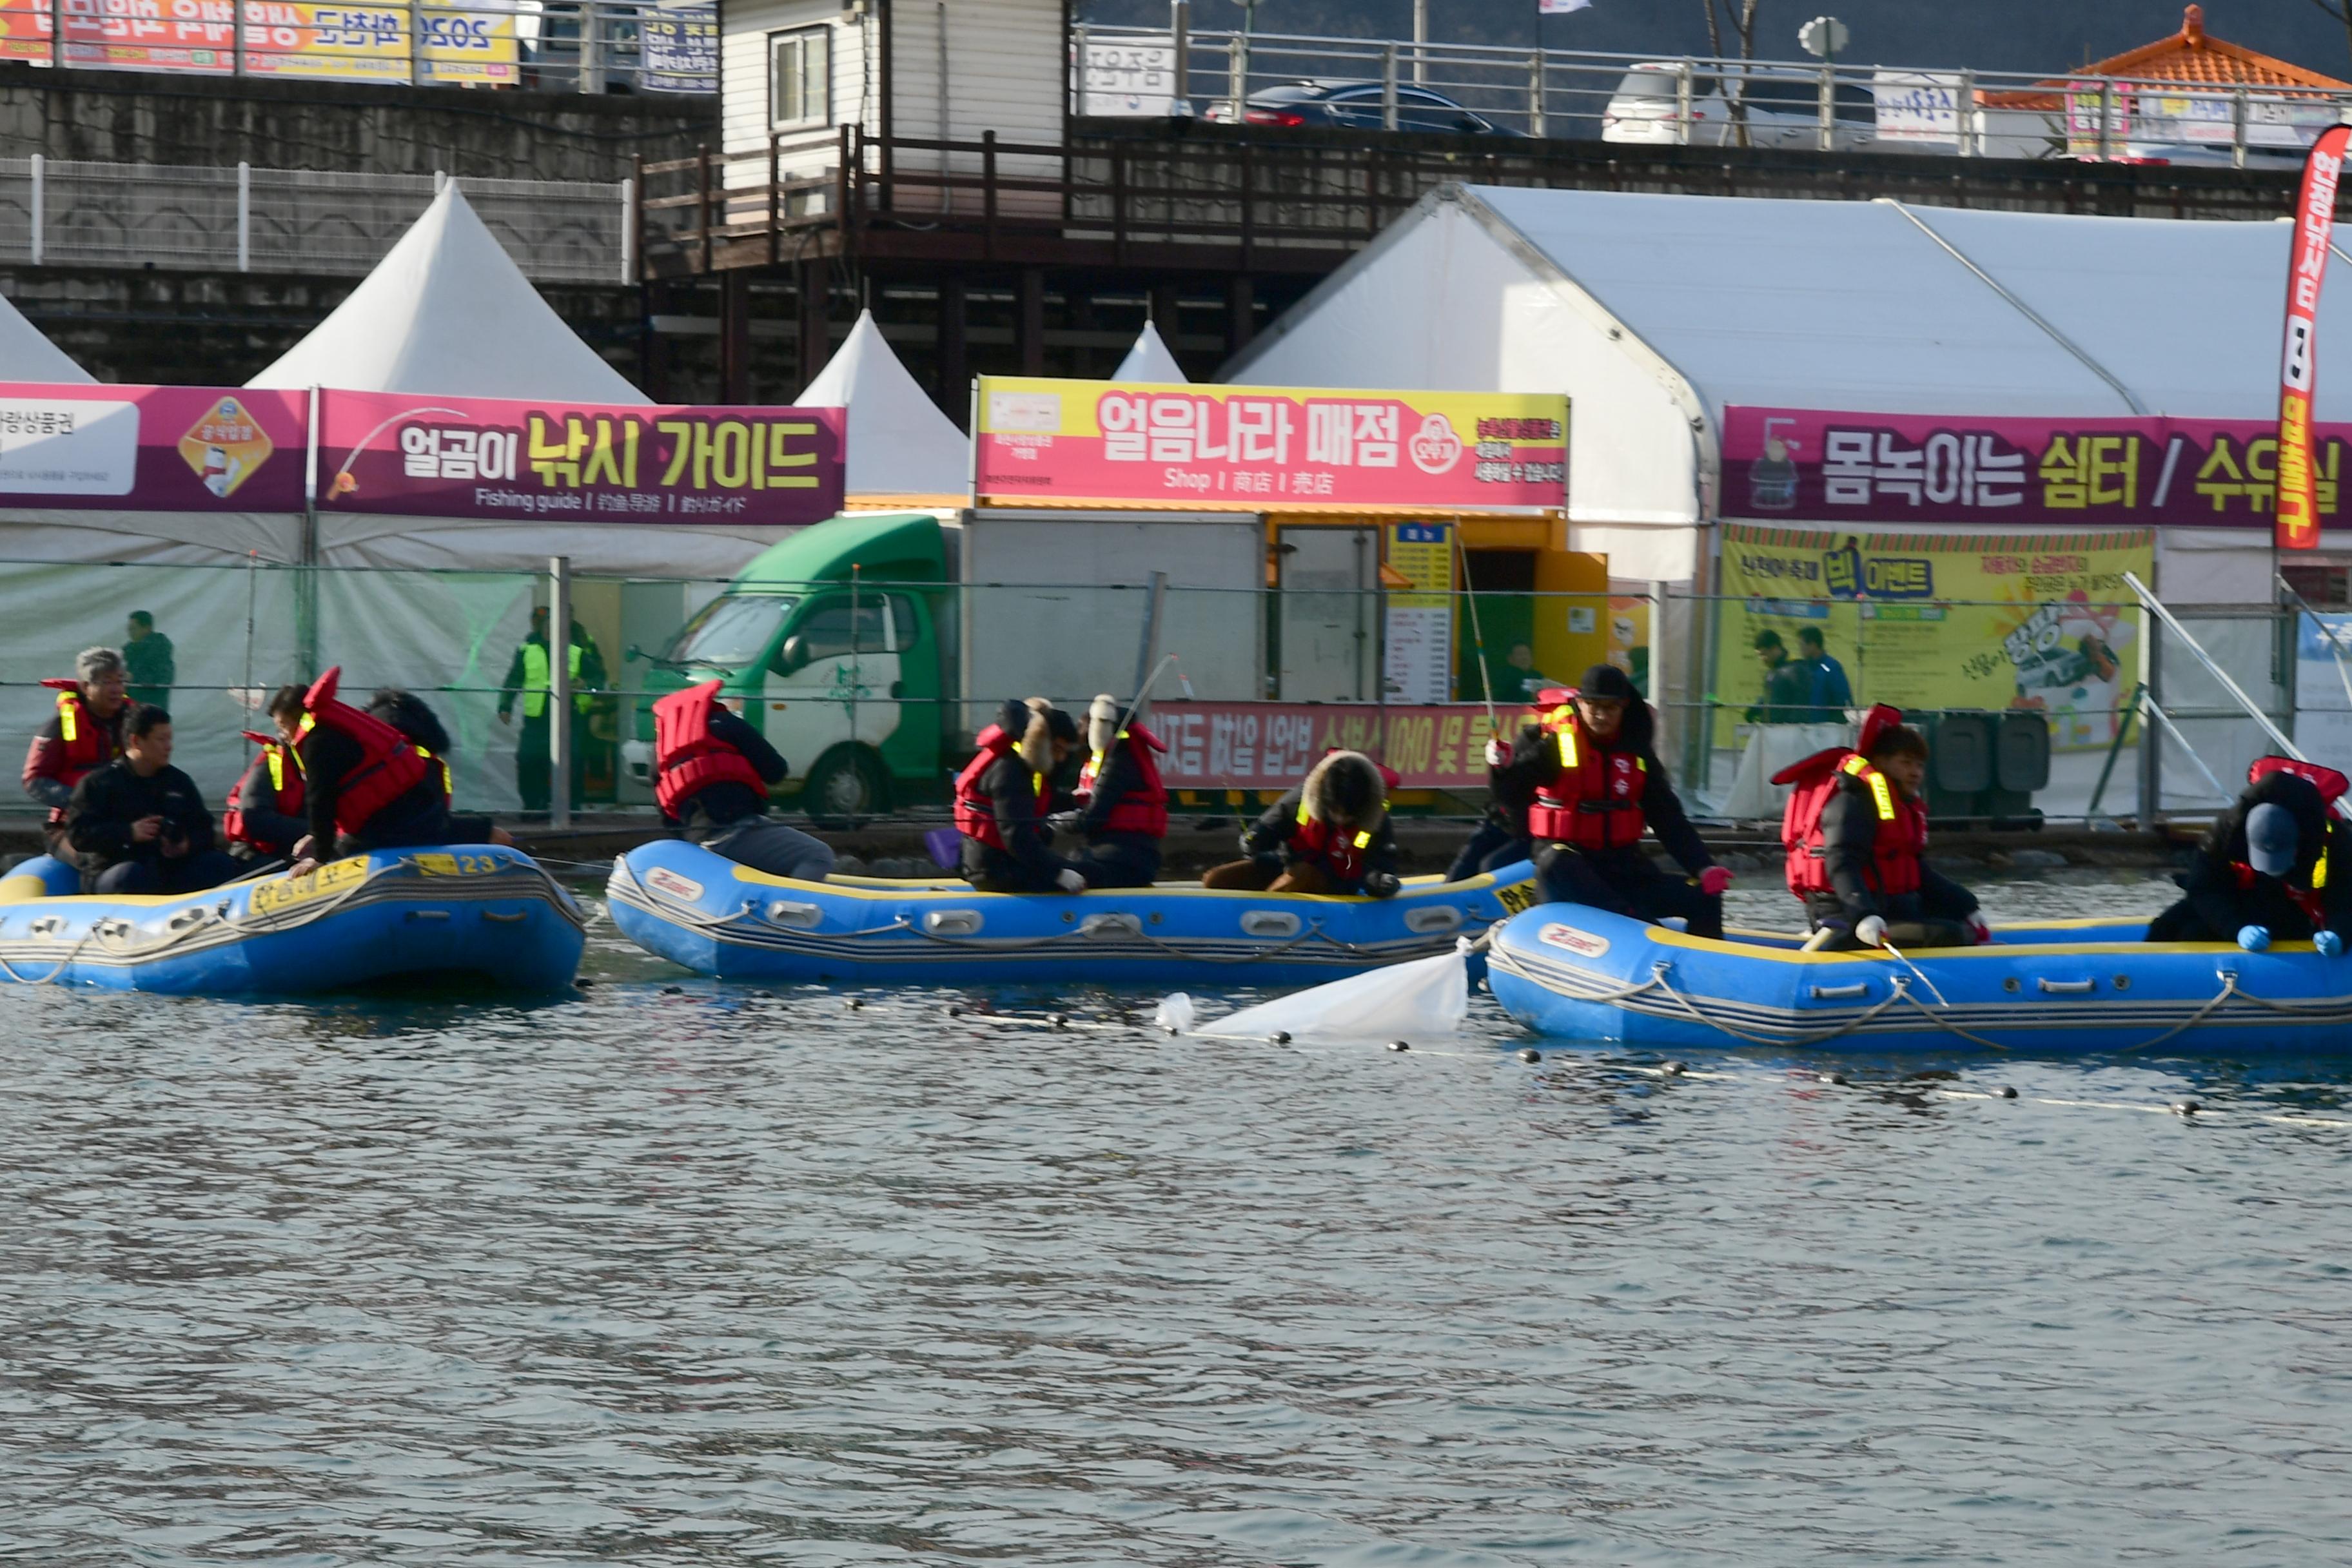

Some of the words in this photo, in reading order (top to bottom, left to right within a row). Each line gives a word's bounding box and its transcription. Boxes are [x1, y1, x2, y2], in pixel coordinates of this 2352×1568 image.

[0, 410, 74, 435] 랑상품권
[1099, 396, 1294, 465] 얼음나라
[1306, 402, 1399, 469] 매점
[400, 427, 518, 480] 얼곰이
[528, 416, 639, 488] 낚시
[657, 420, 820, 491] 가이드
[1164, 467, 1211, 493] Shop
[1823, 429, 2026, 507] 몸녹이는
[2039, 436, 2140, 508] 쉼터
[1232, 470, 1273, 493] 商店
[475, 487, 535, 512] Fishing
[537, 491, 582, 512] guide
[458, 856, 497, 874] 23
